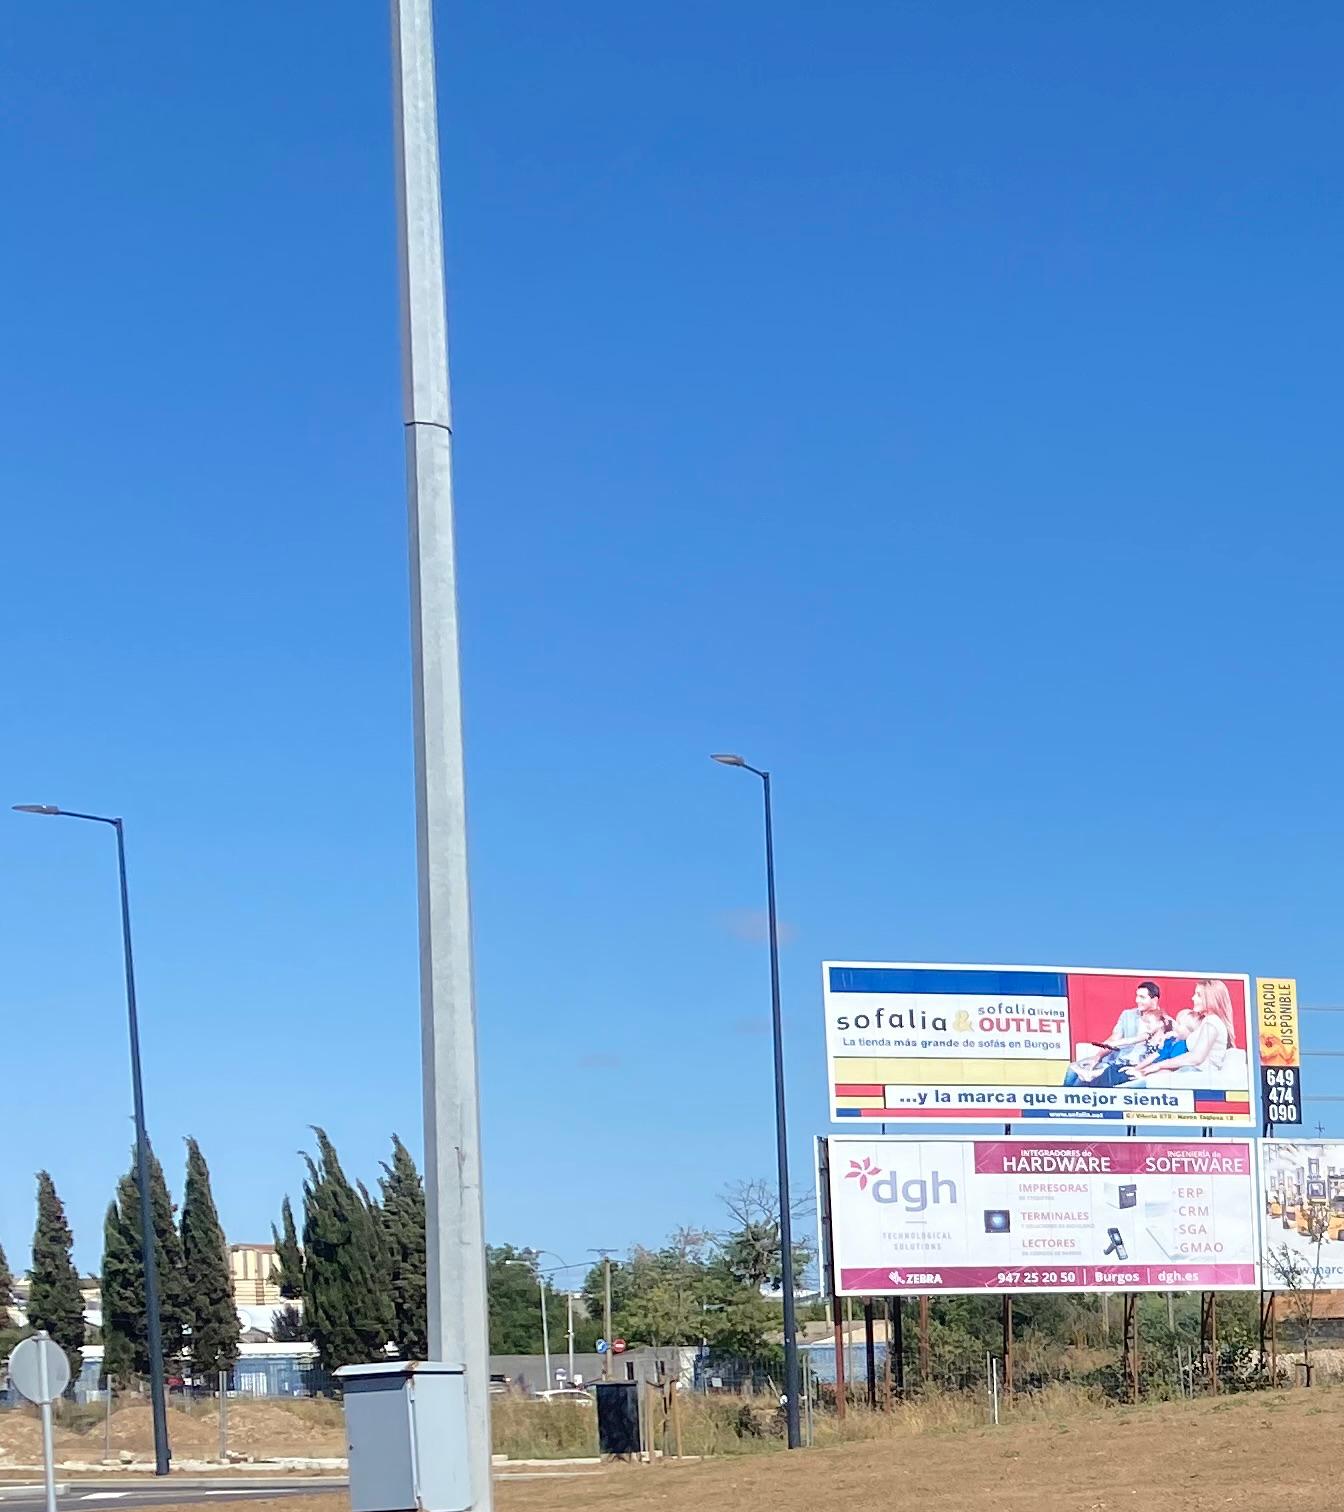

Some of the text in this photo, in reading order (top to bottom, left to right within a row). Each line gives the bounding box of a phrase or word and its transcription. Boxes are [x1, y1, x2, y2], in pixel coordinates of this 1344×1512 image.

[978, 1002, 1036, 1016] sofalia
[1262, 983, 1277, 1027] ESPACIO
[836, 1007, 975, 1032] sofalia &
[1278, 983, 1294, 1045] DISPONIBLE
[978, 1017, 1066, 1034] OUTLET
[842, 1037, 1061, 1051] La tienda más grande de sofás en Burgos
[1266, 1069, 1294, 1086] 649
[935, 1089, 951, 1103] la
[957, 1092, 1017, 1104] marca
[1023, 1093, 1058, 1107] que
[1064, 1091, 1118, 1107] mejor
[1123, 1092, 1179, 1107] sienta
[1268, 1087, 1294, 1103] 474
[1268, 1104, 1297, 1121] 090
[1020, 1150, 1080, 1158] INTEGRADORES
[1002, 1156, 1111, 1173] HARDWARE
[1145, 1156, 1243, 1173] SOFTWARE
[871, 1170, 957, 1212] dgh
[1018, 1183, 1089, 1193] IMPRESORAS
[1178, 1187, 1204, 1198] ERP
[1020, 1211, 1089, 1221] TERMINALES
[1178, 1206, 1209, 1217] CRM
[882, 1232, 952, 1240] TECHNOLOGICAL
[1178, 1224, 1208, 1235] SGA
[1022, 1239, 1076, 1248] LECTORES
[1179, 1242, 1224, 1253] GMAO
[905, 1273, 943, 1284] ZEBRA
[997, 1270, 1199, 1286] 947 25 20 50 Burgos dgh.es
